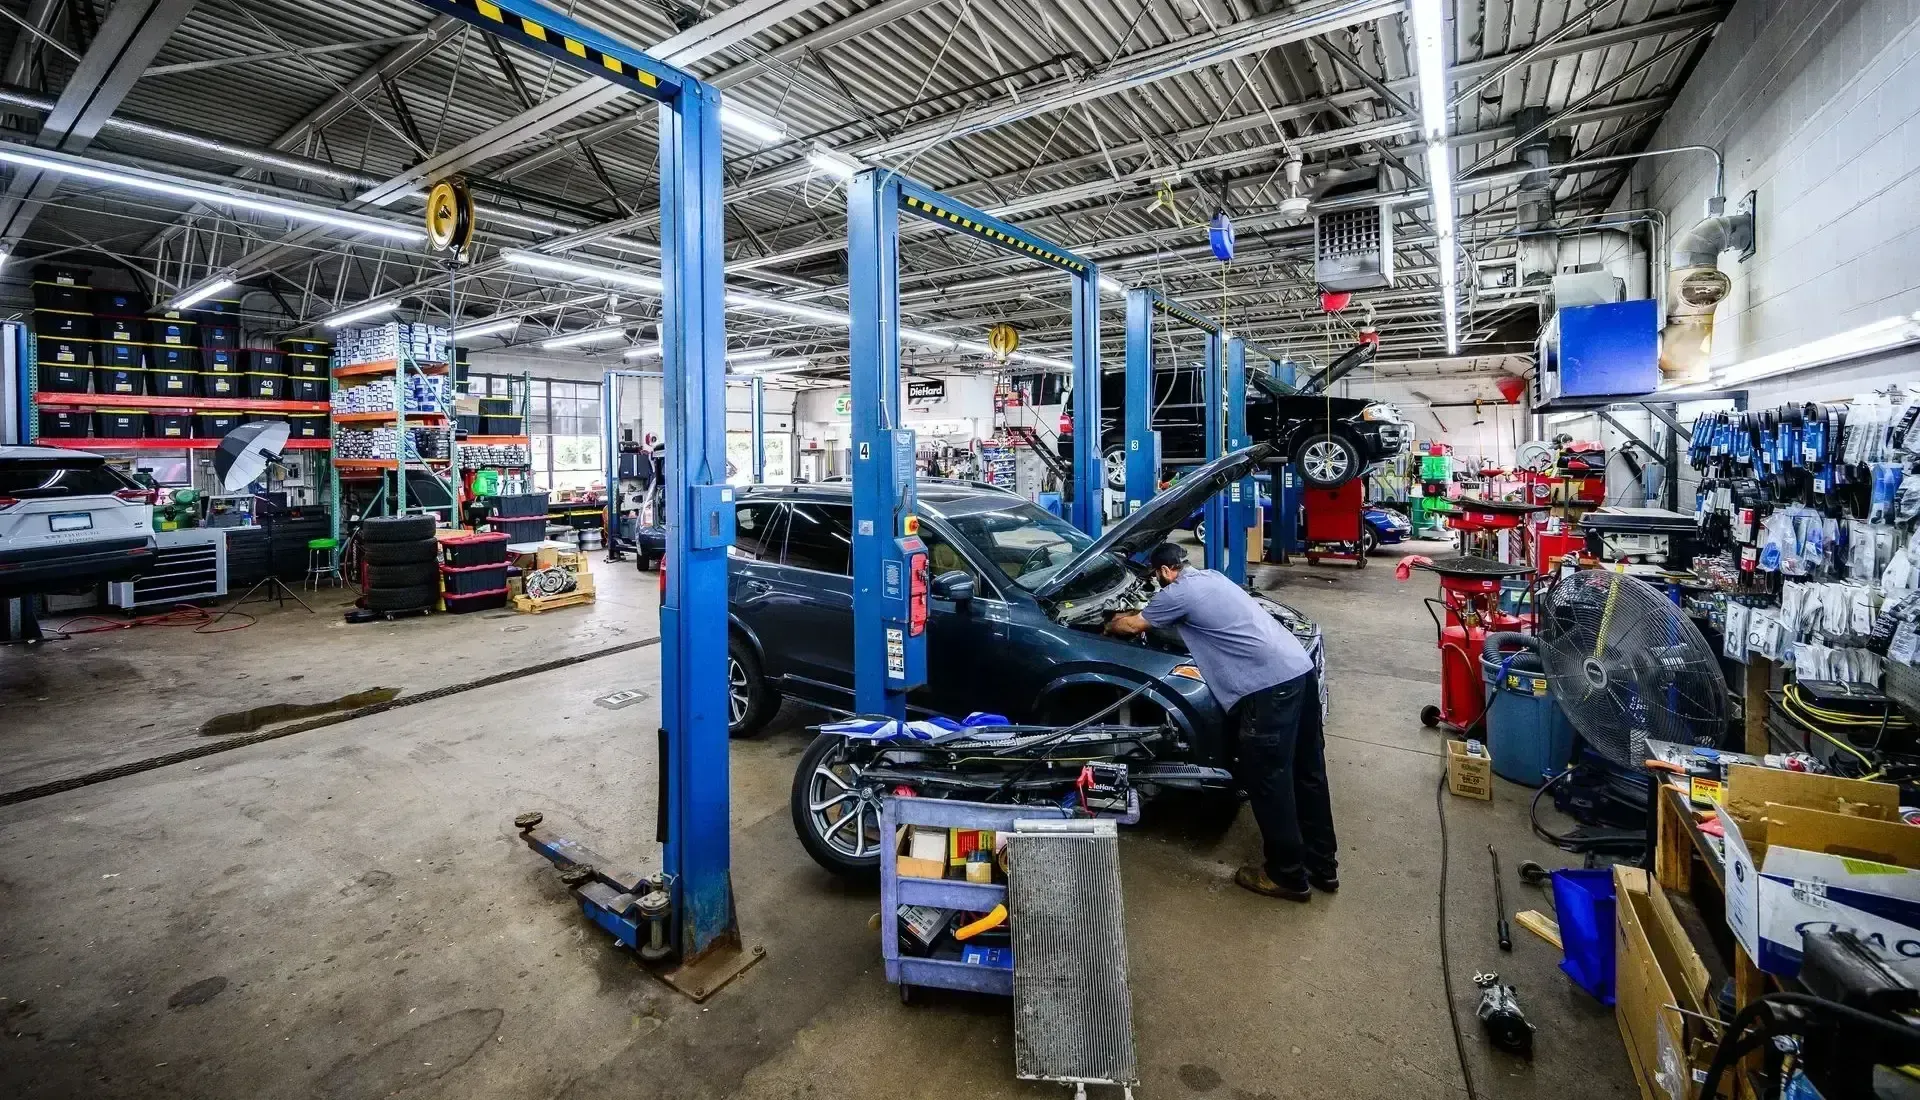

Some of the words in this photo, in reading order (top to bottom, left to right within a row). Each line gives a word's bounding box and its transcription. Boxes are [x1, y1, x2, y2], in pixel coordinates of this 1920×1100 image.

[910, 386, 943, 396] DieHard
[1131, 440, 1139, 450] 3
[860, 443, 868, 458] 4
